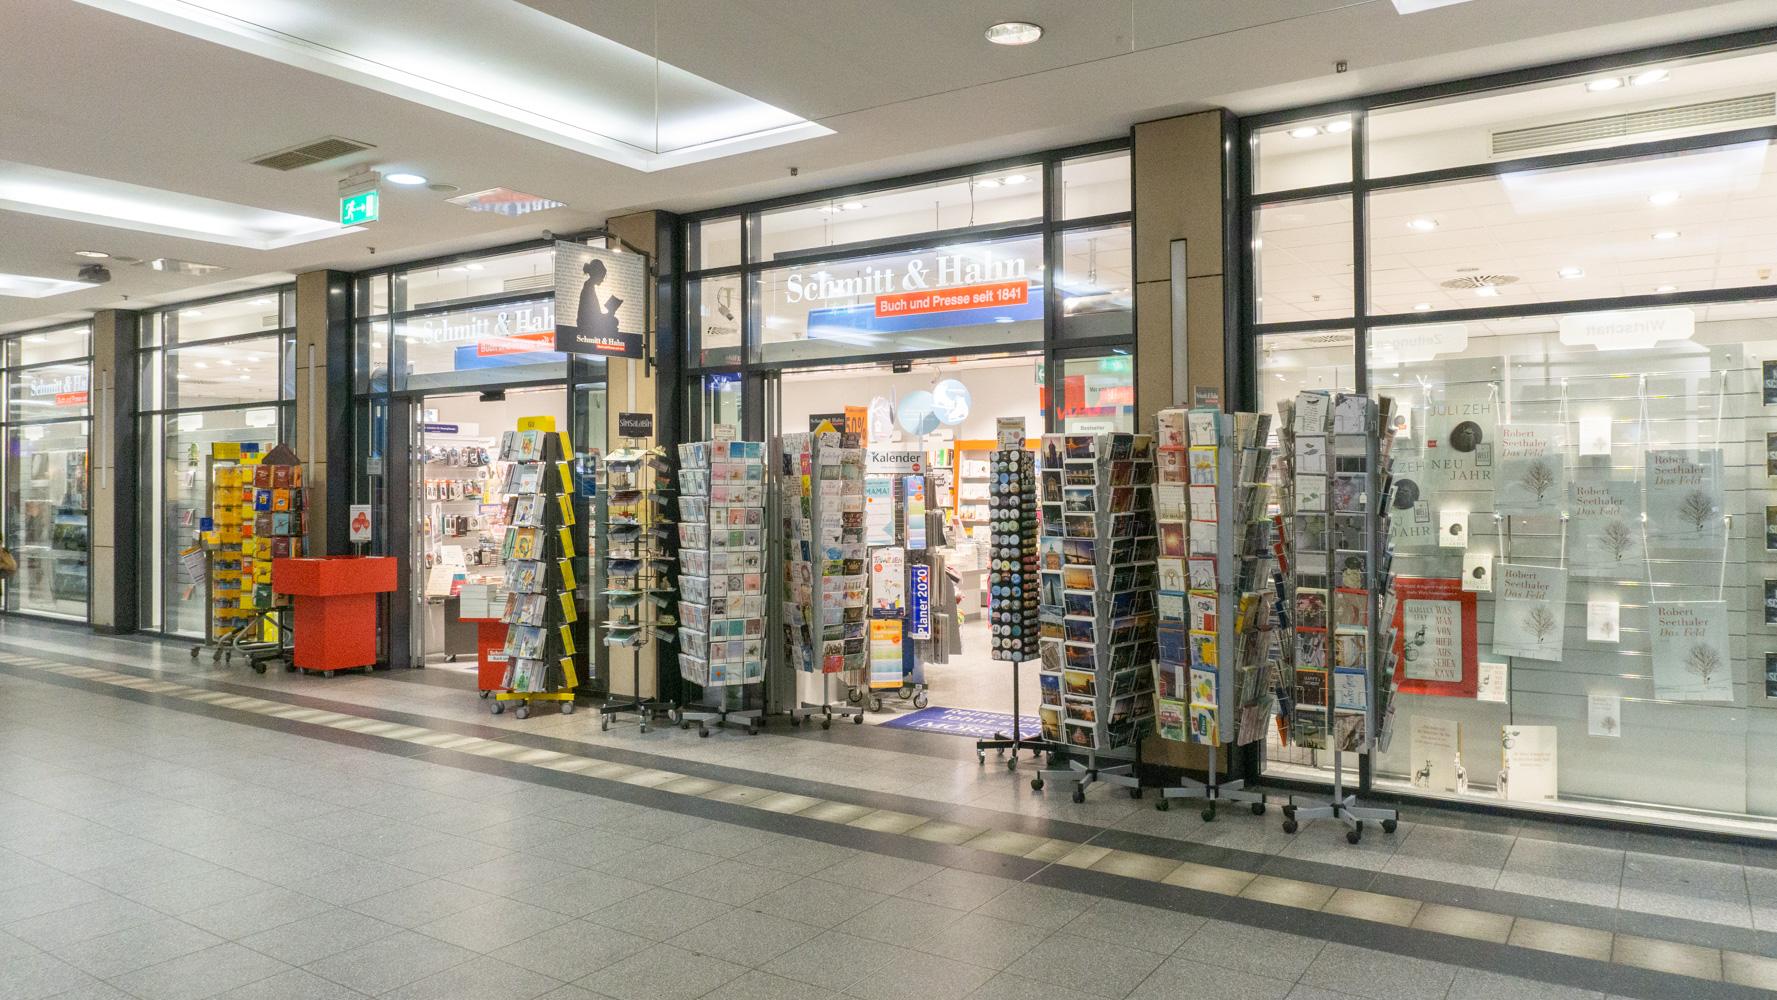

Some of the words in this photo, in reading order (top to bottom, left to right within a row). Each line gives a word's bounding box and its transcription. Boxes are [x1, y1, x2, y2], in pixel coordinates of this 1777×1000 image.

[786, 265, 896, 303] Schmitt
[902, 258, 929, 291] &
[936, 250, 1025, 287] Hahn
[880, 300, 907, 313] Buch
[910, 295, 930, 310] und
[932, 293, 970, 308] Presse
[972, 290, 993, 304] seit
[996, 287, 1021, 301] 1841
[423, 317, 489, 344] Schmitt
[495, 311, 510, 336] &
[514, 306, 555, 332] Hah
[576, 335, 601, 344] Schmitt
[609, 338, 625, 346] Hahn
[1430, 405, 1459, 416] JULI
[1463, 403, 1491, 415] ZEH
[1503, 429, 1534, 437] Robert
[1503, 439, 1547, 448] Seethaler
[872, 452, 921, 463] Kalender
[1523, 449, 1544, 457] Feld
[1432, 459, 1463, 469] NEU
[1655, 466, 1704, 474] Seethaler
[1449, 470, 1492, 481] JAHR
[1655, 477, 1675, 485] Das
[1679, 476, 1701, 485] Feld
[1576, 487, 1610, 496] Robert
[1576, 497, 1624, 506] Seethaler
[1576, 508, 1596, 516] Das
[1599, 507, 1620, 516] Feld
[1505, 569, 1537, 580] Robert
[917, 569, 928, 598] 2020
[1504, 579, 1550, 590] Seethaler
[1504, 589, 1522, 598] Das
[1525, 591, 1545, 600] Feld
[1436, 606, 1452, 615] WAS
[1658, 607, 1694, 616] Robert
[917, 599, 928, 634] Planer
[1659, 618, 1708, 626] Seethaler
[1659, 629, 1679, 637] Das
[1683, 628, 1705, 637] Feld
